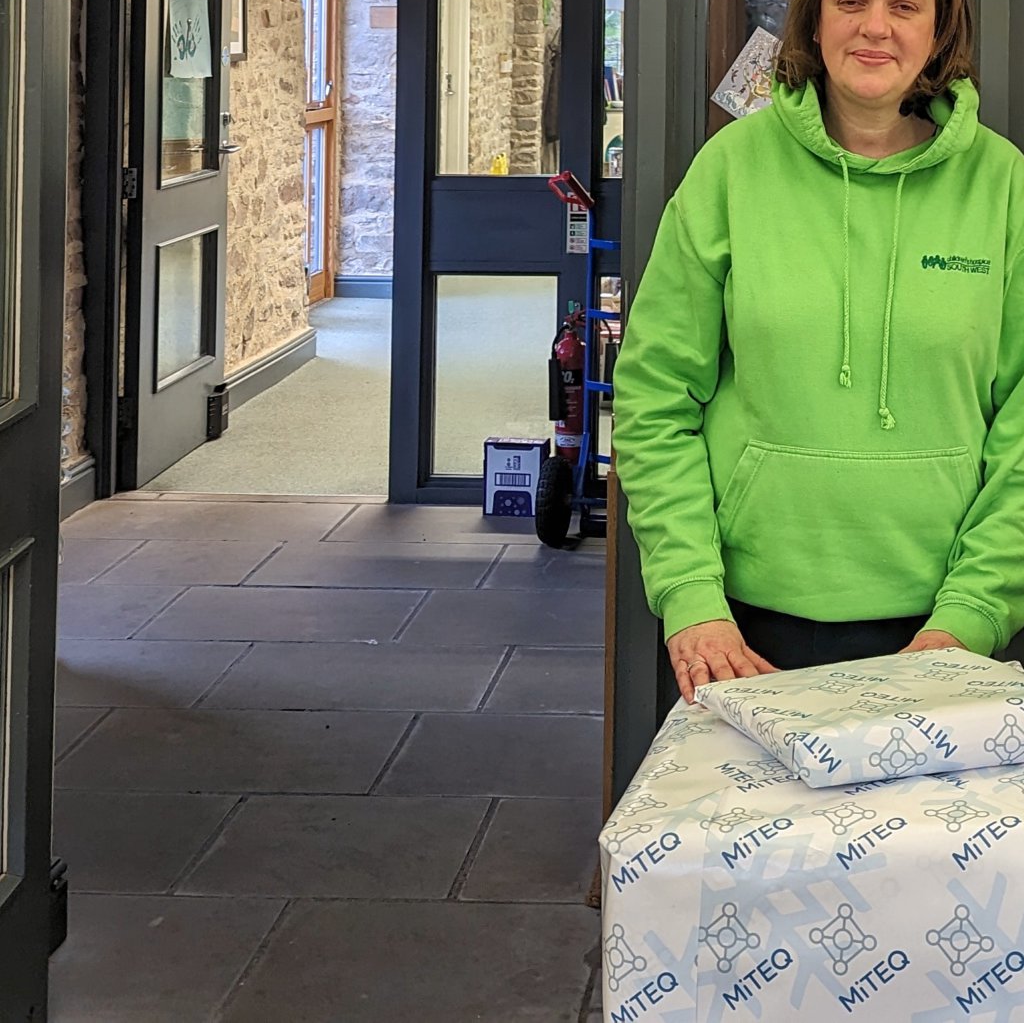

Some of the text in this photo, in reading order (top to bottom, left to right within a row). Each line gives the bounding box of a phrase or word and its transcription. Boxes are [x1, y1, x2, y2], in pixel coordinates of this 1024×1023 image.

[829, 671, 890, 683] MiTEQ
[932, 661, 992, 672] MiTEQ
[860, 691, 924, 704] MiTEQ
[894, 711, 959, 759] MiTEQ
[611, 832, 682, 893] MiTEQ
[720, 818, 794, 869] MiTEQ
[835, 817, 908, 870] MiTEQ
[951, 816, 1023, 871] MiTEQ
[610, 971, 679, 1023] MiTEQ
[722, 948, 794, 1011] MiTEQ
[838, 950, 911, 1012] MiTEQ
